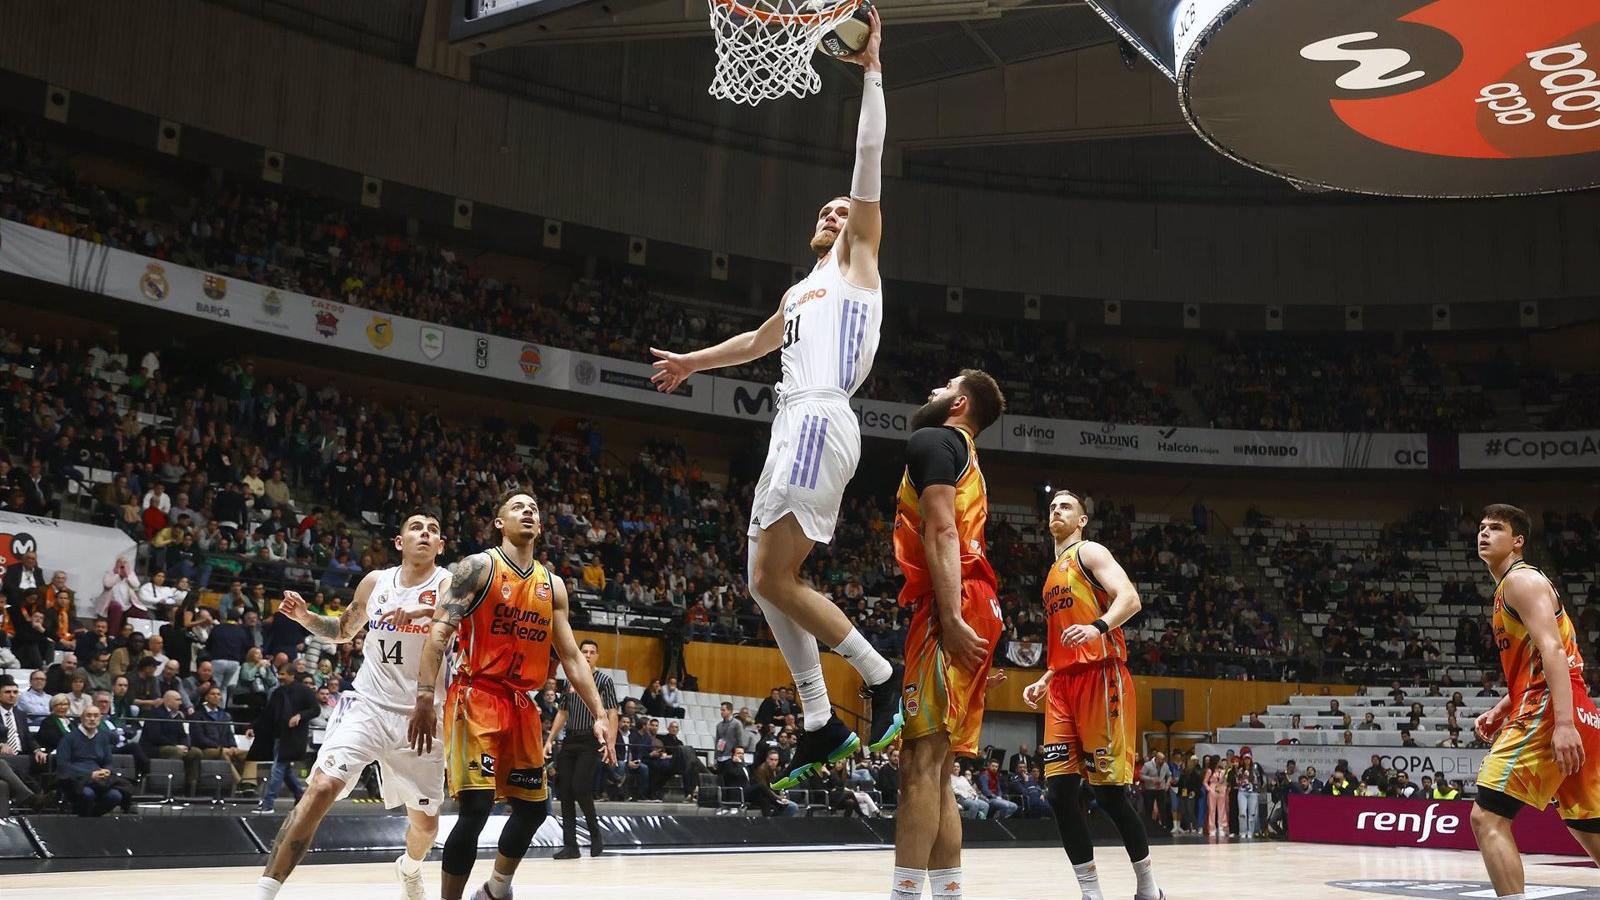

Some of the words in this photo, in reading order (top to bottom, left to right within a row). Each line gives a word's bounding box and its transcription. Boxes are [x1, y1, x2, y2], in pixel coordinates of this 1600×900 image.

[1474, 82, 1536, 126] acb
[195, 302, 231, 318] BARÇA
[783, 314, 801, 350] 31
[1013, 424, 1055, 440] divina
[1079, 430, 1139, 449] SPALDING
[1157, 441, 1199, 454] Halcón
[1244, 444, 1298, 457] MONDO
[1485, 436, 1600, 460] #CopaA
[25, 516, 60, 528] REY
[378, 639, 404, 665] 14
[1380, 755, 1435, 774] COPA
[1441, 756, 1475, 774] DEL
[1356, 803, 1460, 842] renfe
